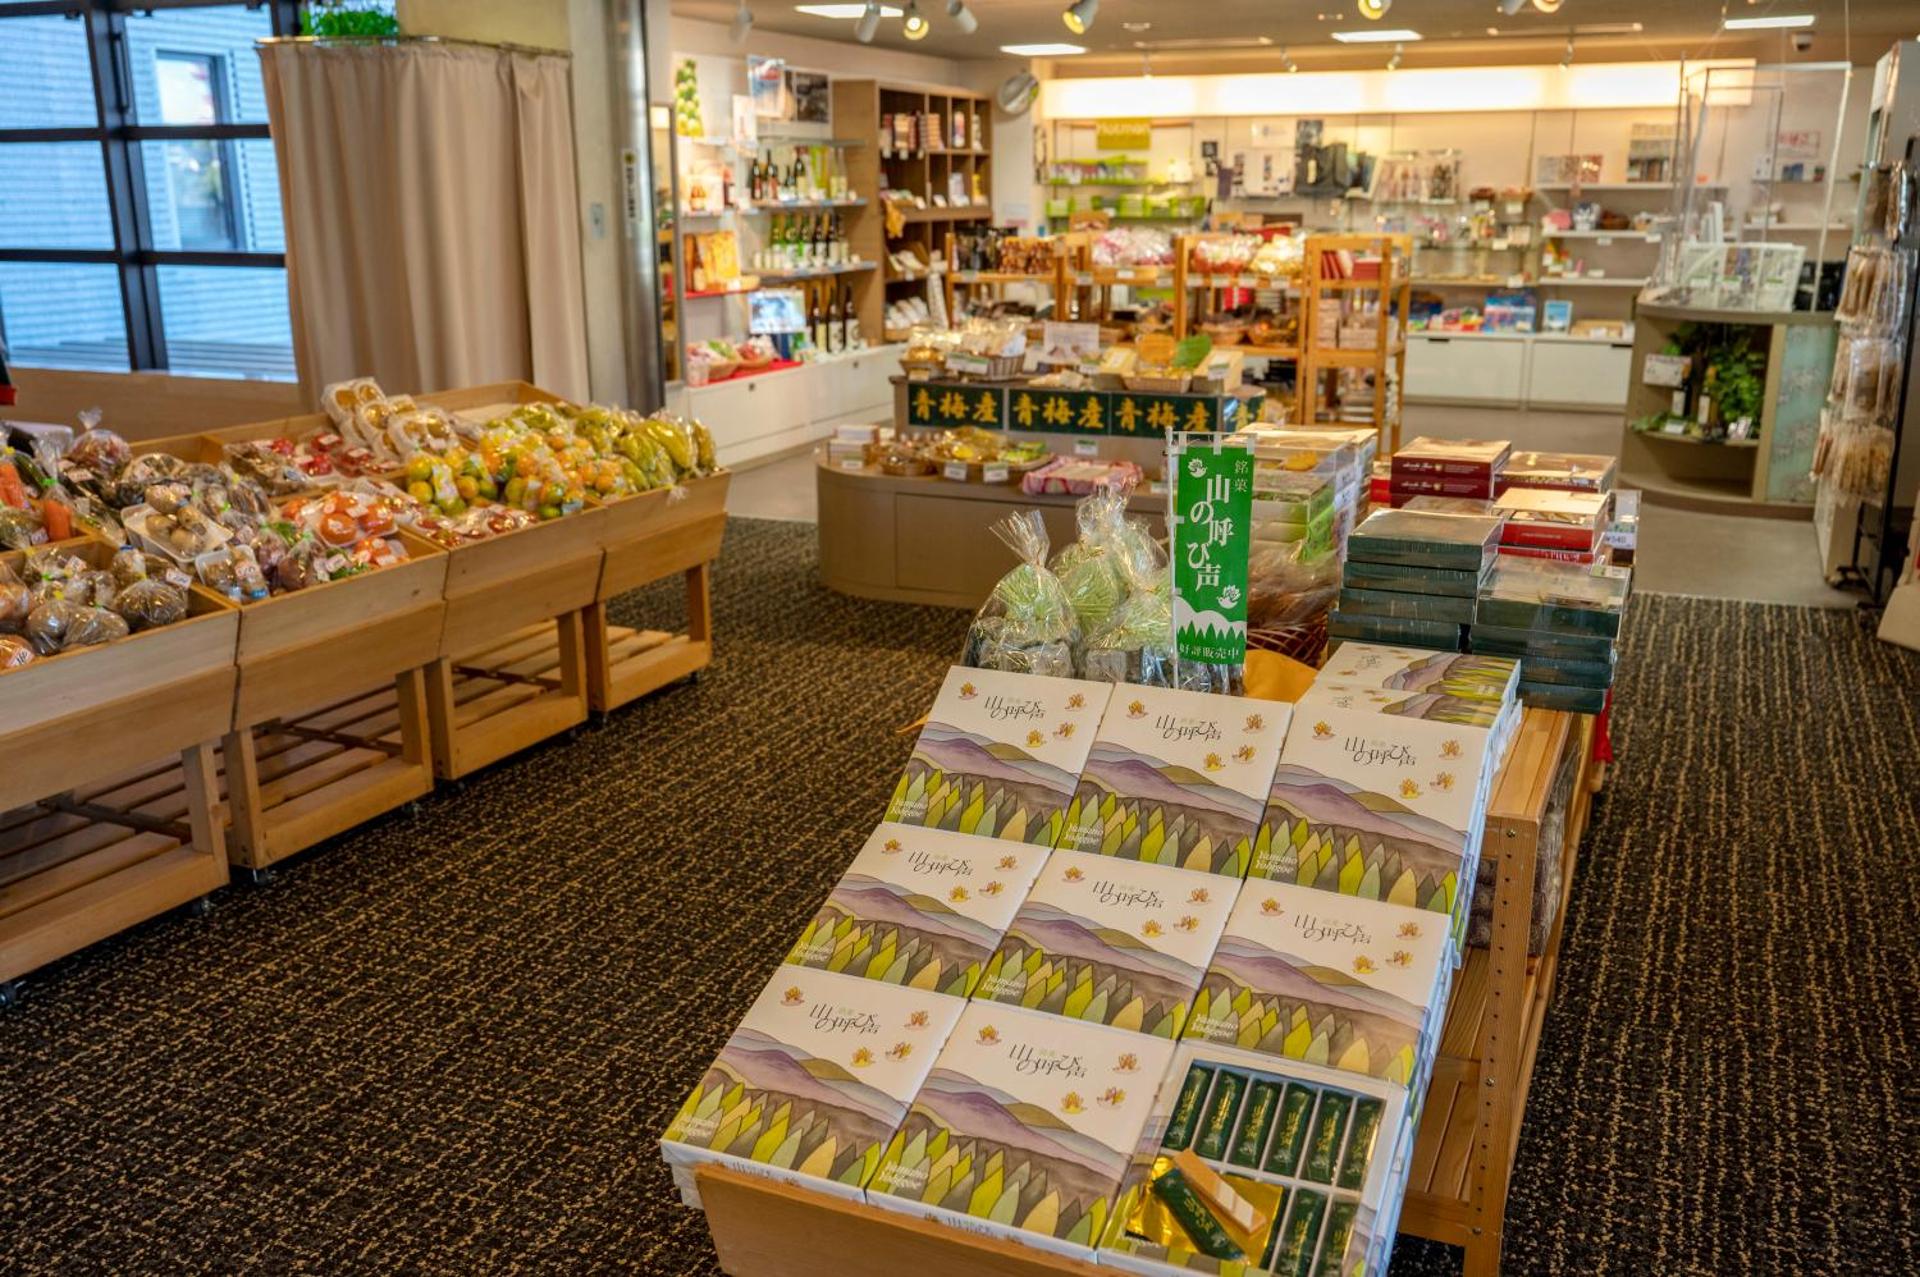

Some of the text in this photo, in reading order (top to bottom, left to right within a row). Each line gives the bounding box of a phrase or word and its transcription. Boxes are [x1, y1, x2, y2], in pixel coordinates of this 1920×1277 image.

[911, 388, 998, 424] 青梅産
[1012, 392, 1105, 430] 青梅産
[1114, 397, 1211, 432] 青梅産
[1187, 473, 1235, 592] 山の呼び声
